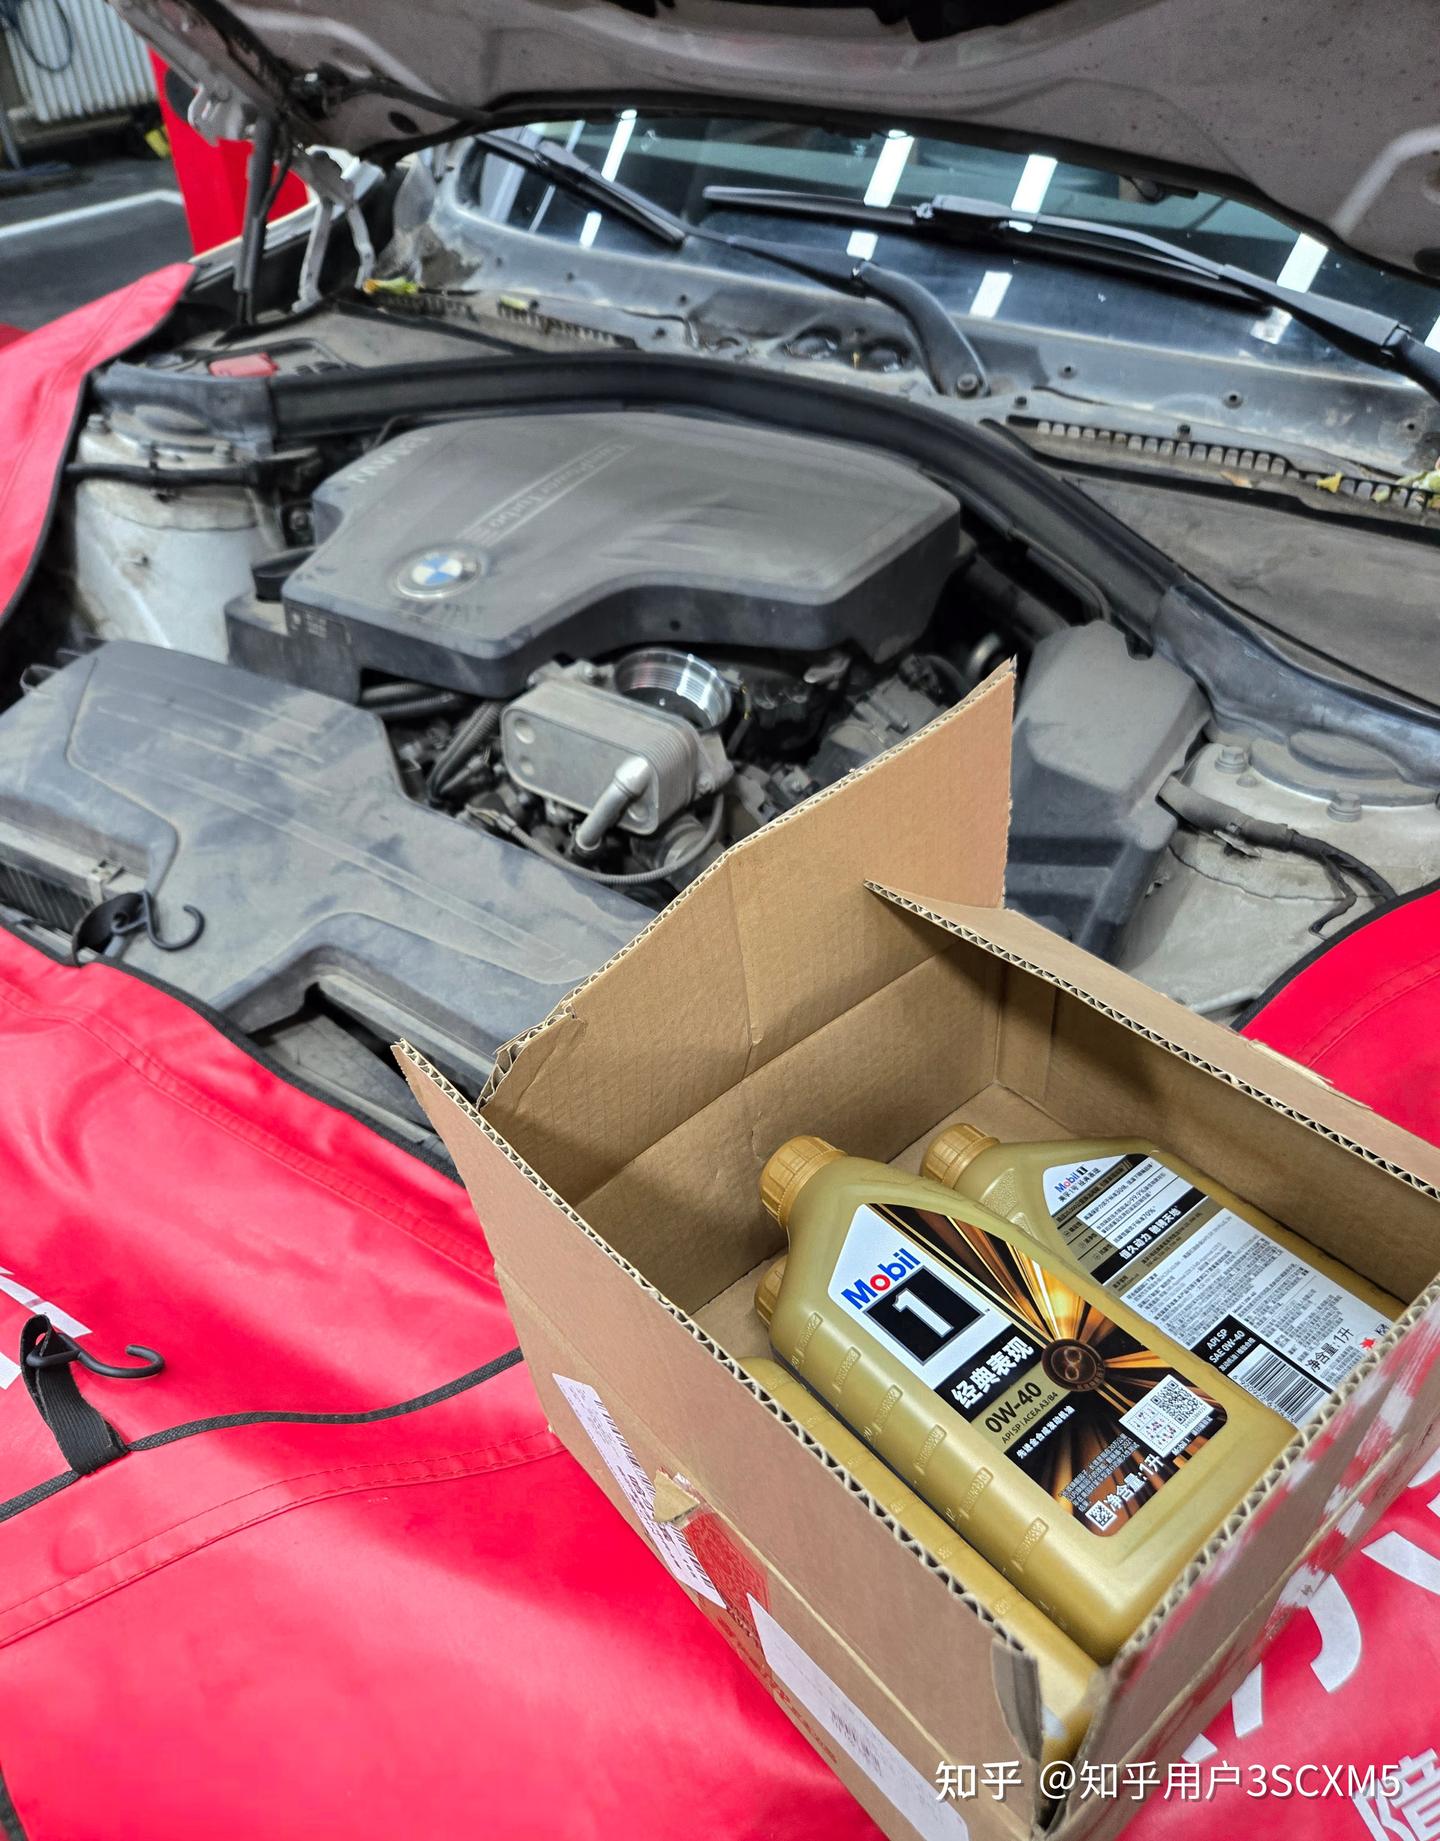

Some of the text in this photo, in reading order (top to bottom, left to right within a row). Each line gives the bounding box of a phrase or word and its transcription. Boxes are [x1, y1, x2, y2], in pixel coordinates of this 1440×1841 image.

[841, 1248, 921, 1310] Mobil
[892, 1287, 955, 1339] 1
[1206, 1328, 1228, 1350] API SP
[951, 1336, 1035, 1409] 经典表现
[1209, 1330, 1246, 1363] SAE 0W-40
[985, 1382, 1042, 1433] 0W-40
[1001, 1391, 1059, 1445] API SP ACEA A3/B4
